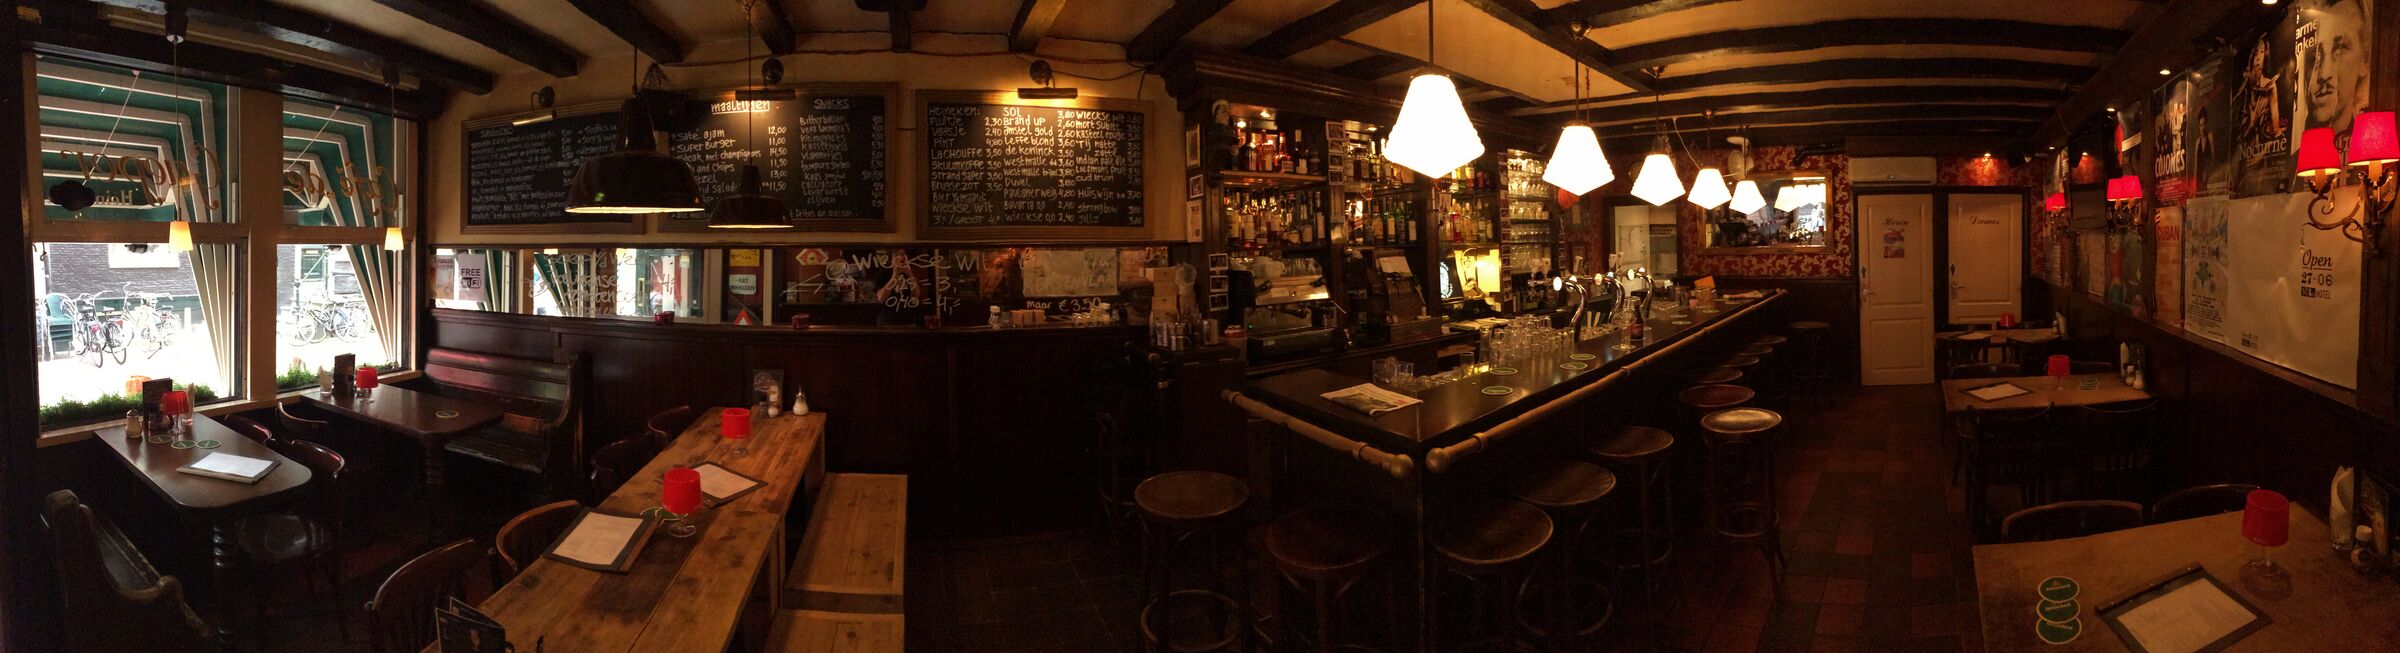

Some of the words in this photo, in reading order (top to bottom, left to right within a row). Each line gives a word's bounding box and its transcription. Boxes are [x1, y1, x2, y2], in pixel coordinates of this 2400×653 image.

[1003, 107, 1022, 117] SOL
[1003, 114, 1030, 126] Brand
[2302, 249, 2334, 270] Open
[461, 268, 481, 276] FREE
